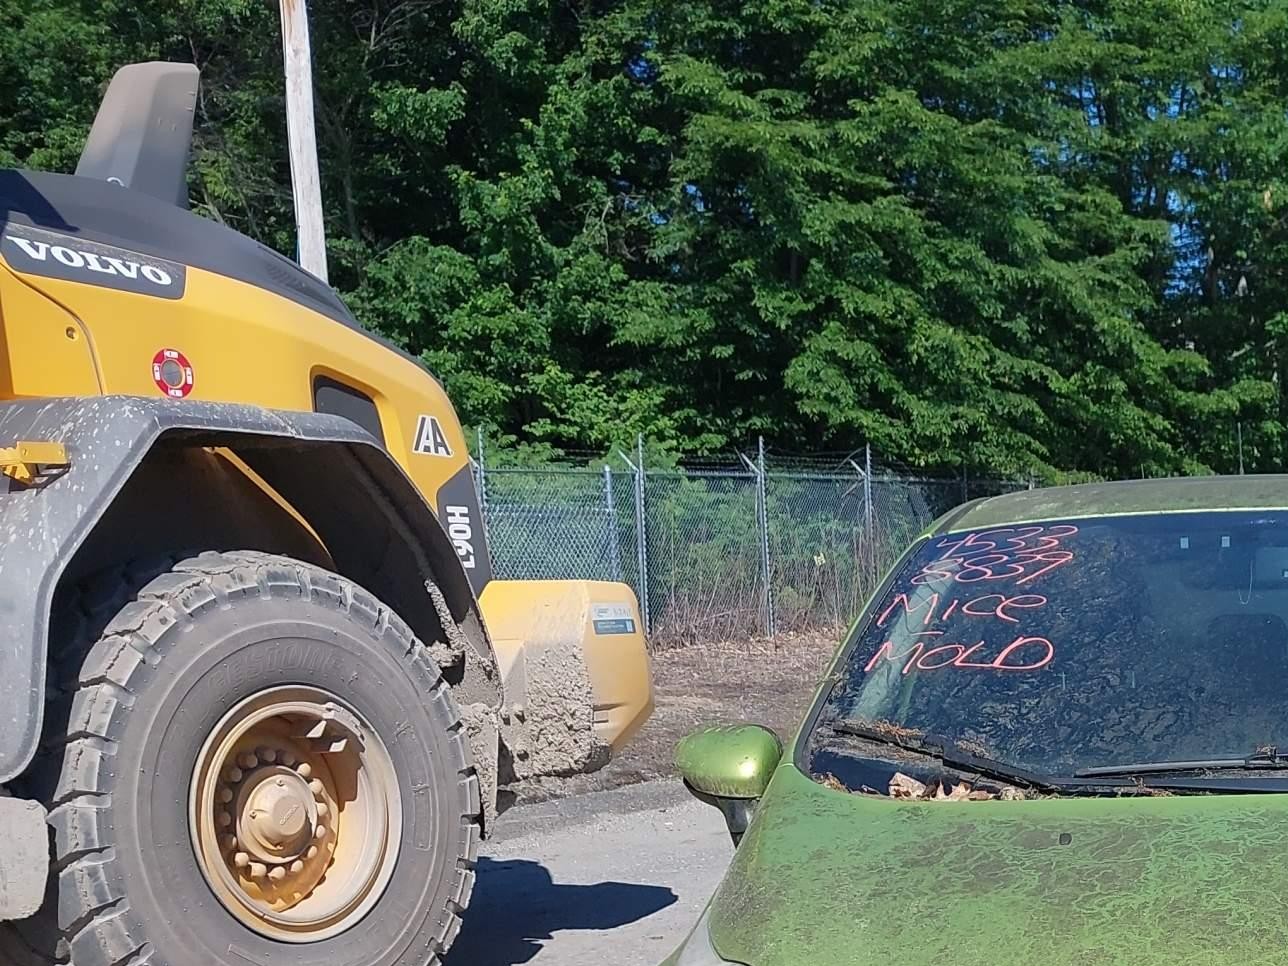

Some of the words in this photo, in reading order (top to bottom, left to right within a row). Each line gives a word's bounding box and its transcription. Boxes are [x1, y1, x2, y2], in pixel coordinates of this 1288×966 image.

[6, 235, 172, 285] VOLVO
[413, 416, 452, 457] IAA
[937, 526, 1079, 559] 4533
[864, 636, 1054, 674] MOLD
